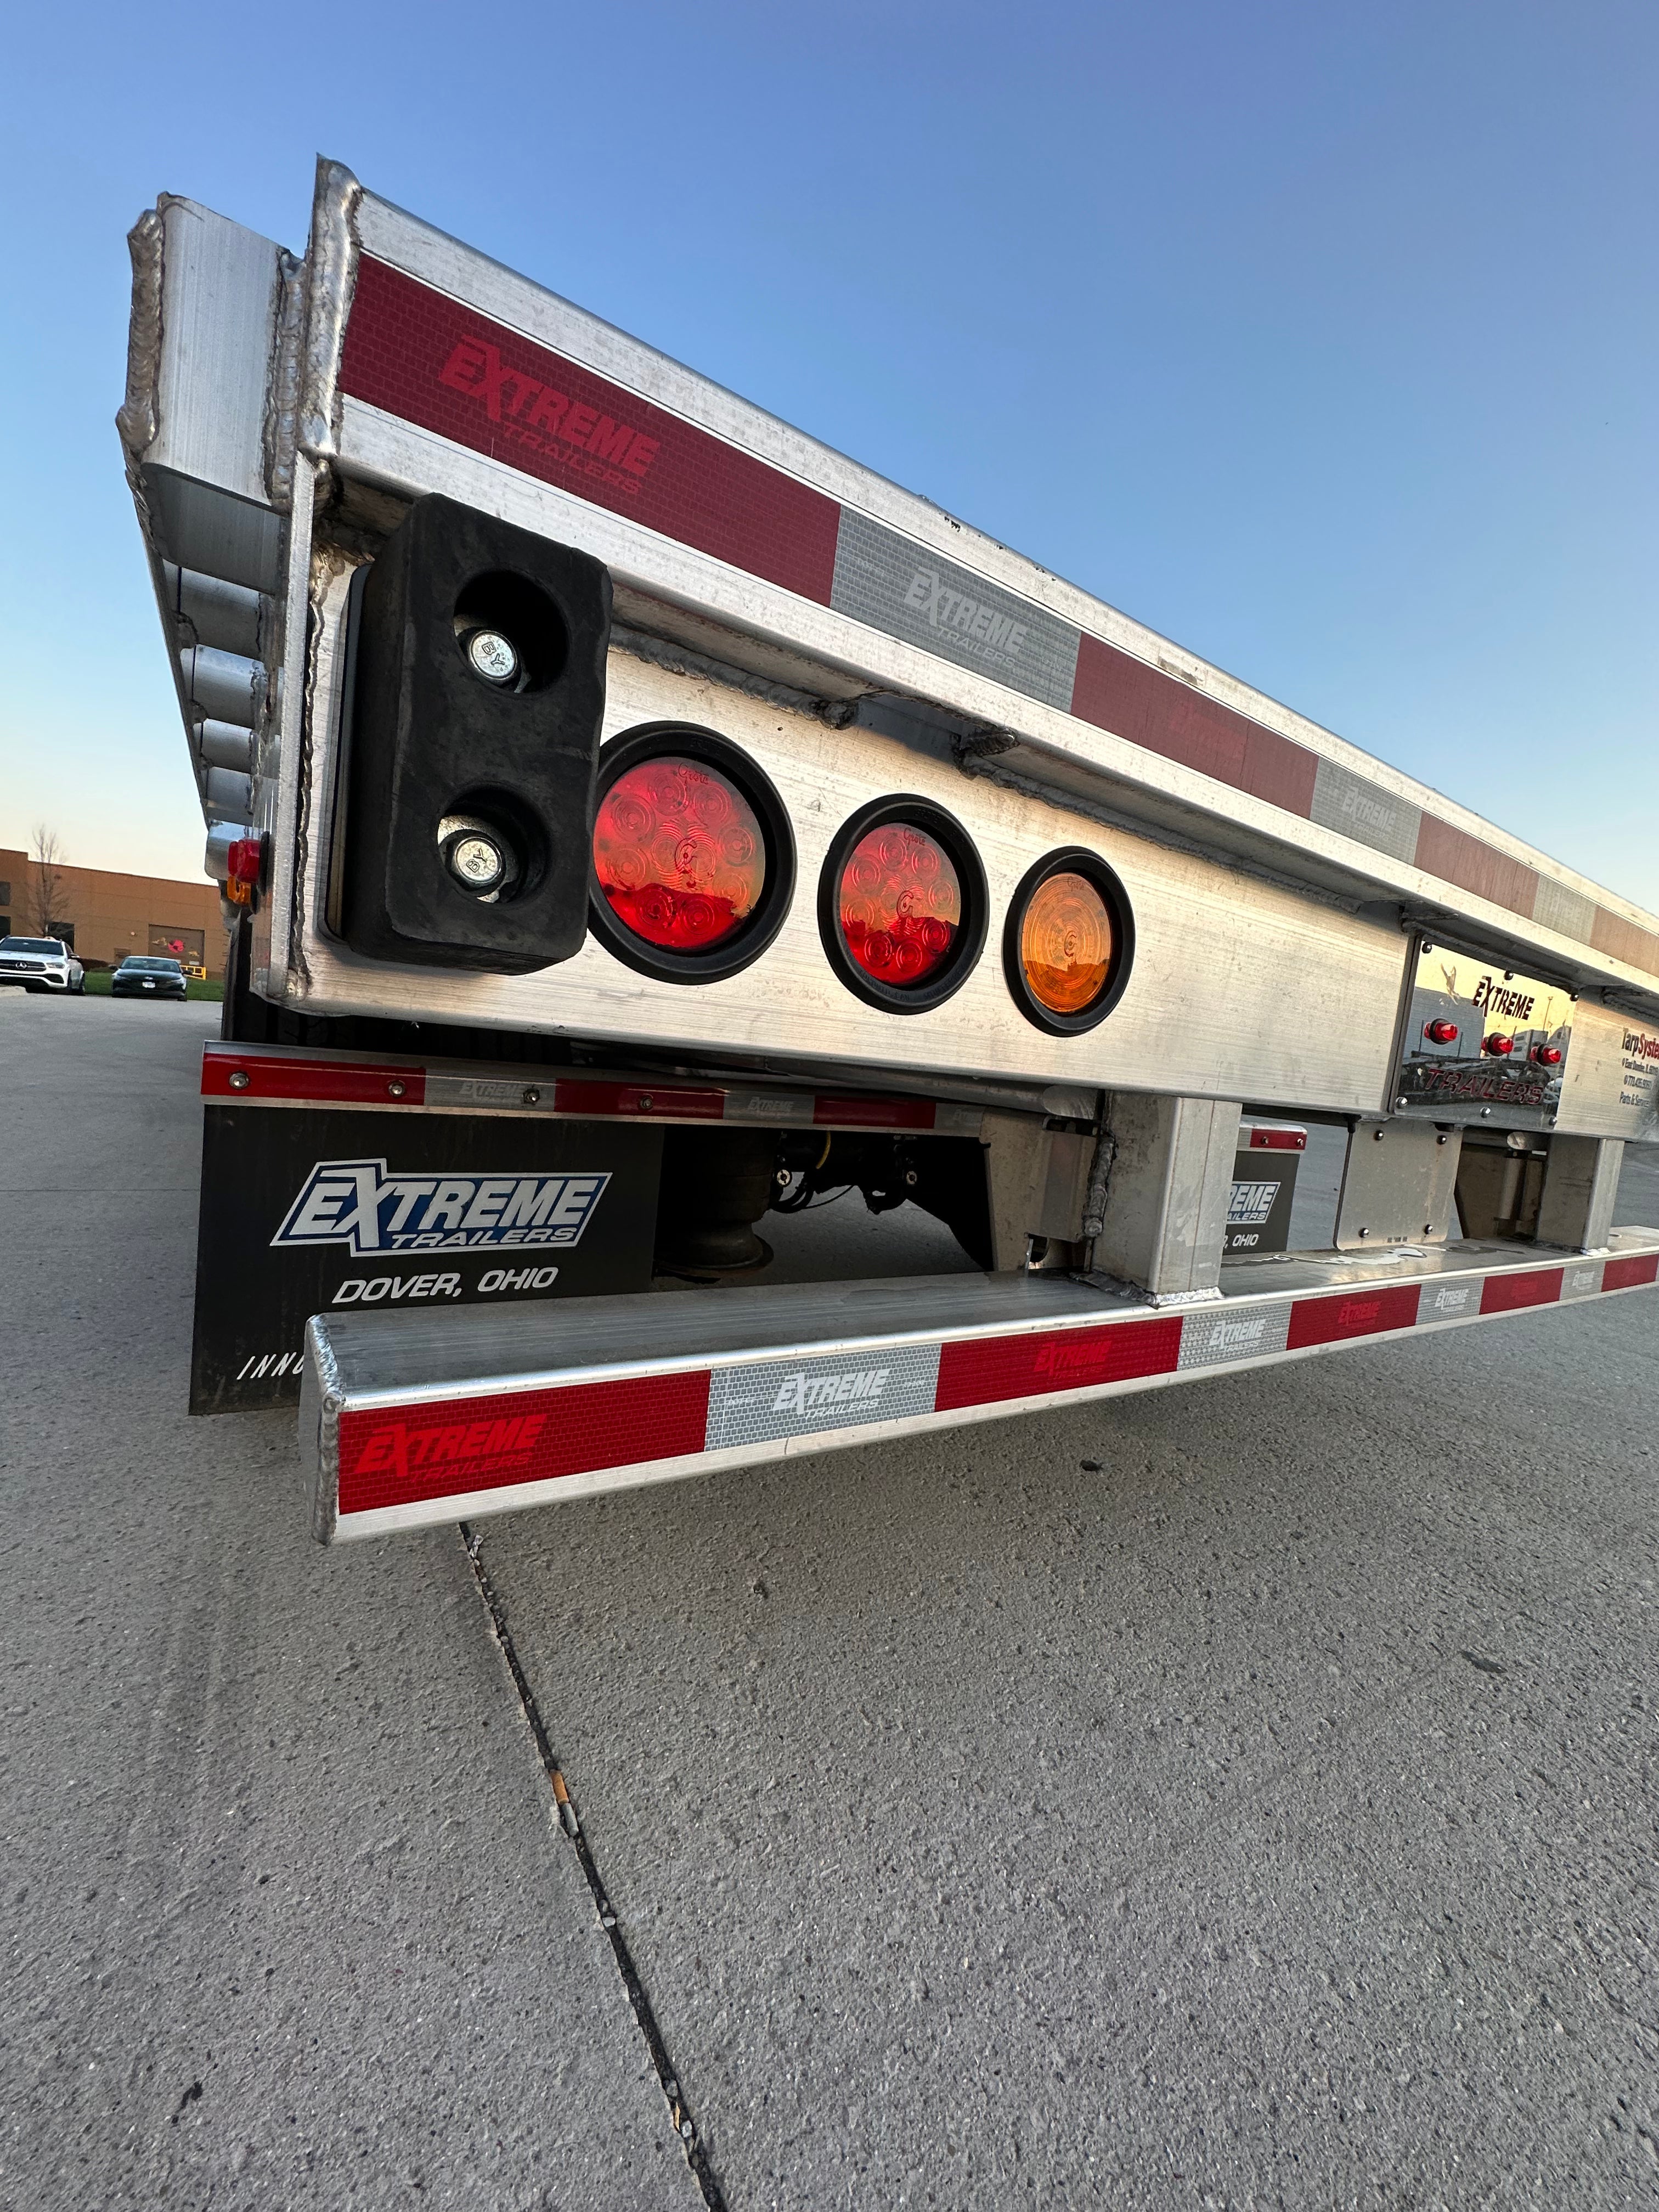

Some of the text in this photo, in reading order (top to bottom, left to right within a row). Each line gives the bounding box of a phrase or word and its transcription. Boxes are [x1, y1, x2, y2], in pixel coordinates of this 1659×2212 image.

[440, 335, 659, 477] EXTREME
[502, 421, 643, 493] TRAILERS
[903, 567, 1030, 652] EXTREME
[937, 627, 1015, 668] TRAILERS
[1471, 975, 1535, 1020] EXTREME
[1621, 1027, 1659, 1060] TarpSyste
[459, 1080, 525, 1099] EXTREME
[748, 1096, 795, 1113] EXTREME
[1426, 1068, 1544, 1105] TRAILERS
[289, 1167, 598, 1249] EXTREME
[391, 1226, 578, 1249] TRAILERS
[1232, 1234, 1260, 1247] OHIO
[332, 1267, 559, 1305] DOVER, OHIO
[1209, 1319, 1266, 1349] EXTREME
[1034, 1340, 1112, 1376] EXTREME
[773, 1369, 890, 1415] EXTREME
[805, 1398, 880, 1420] TRAILERS
[354, 1413, 548, 1477] EXTREME
[410, 1452, 532, 1482] TRAILERS
